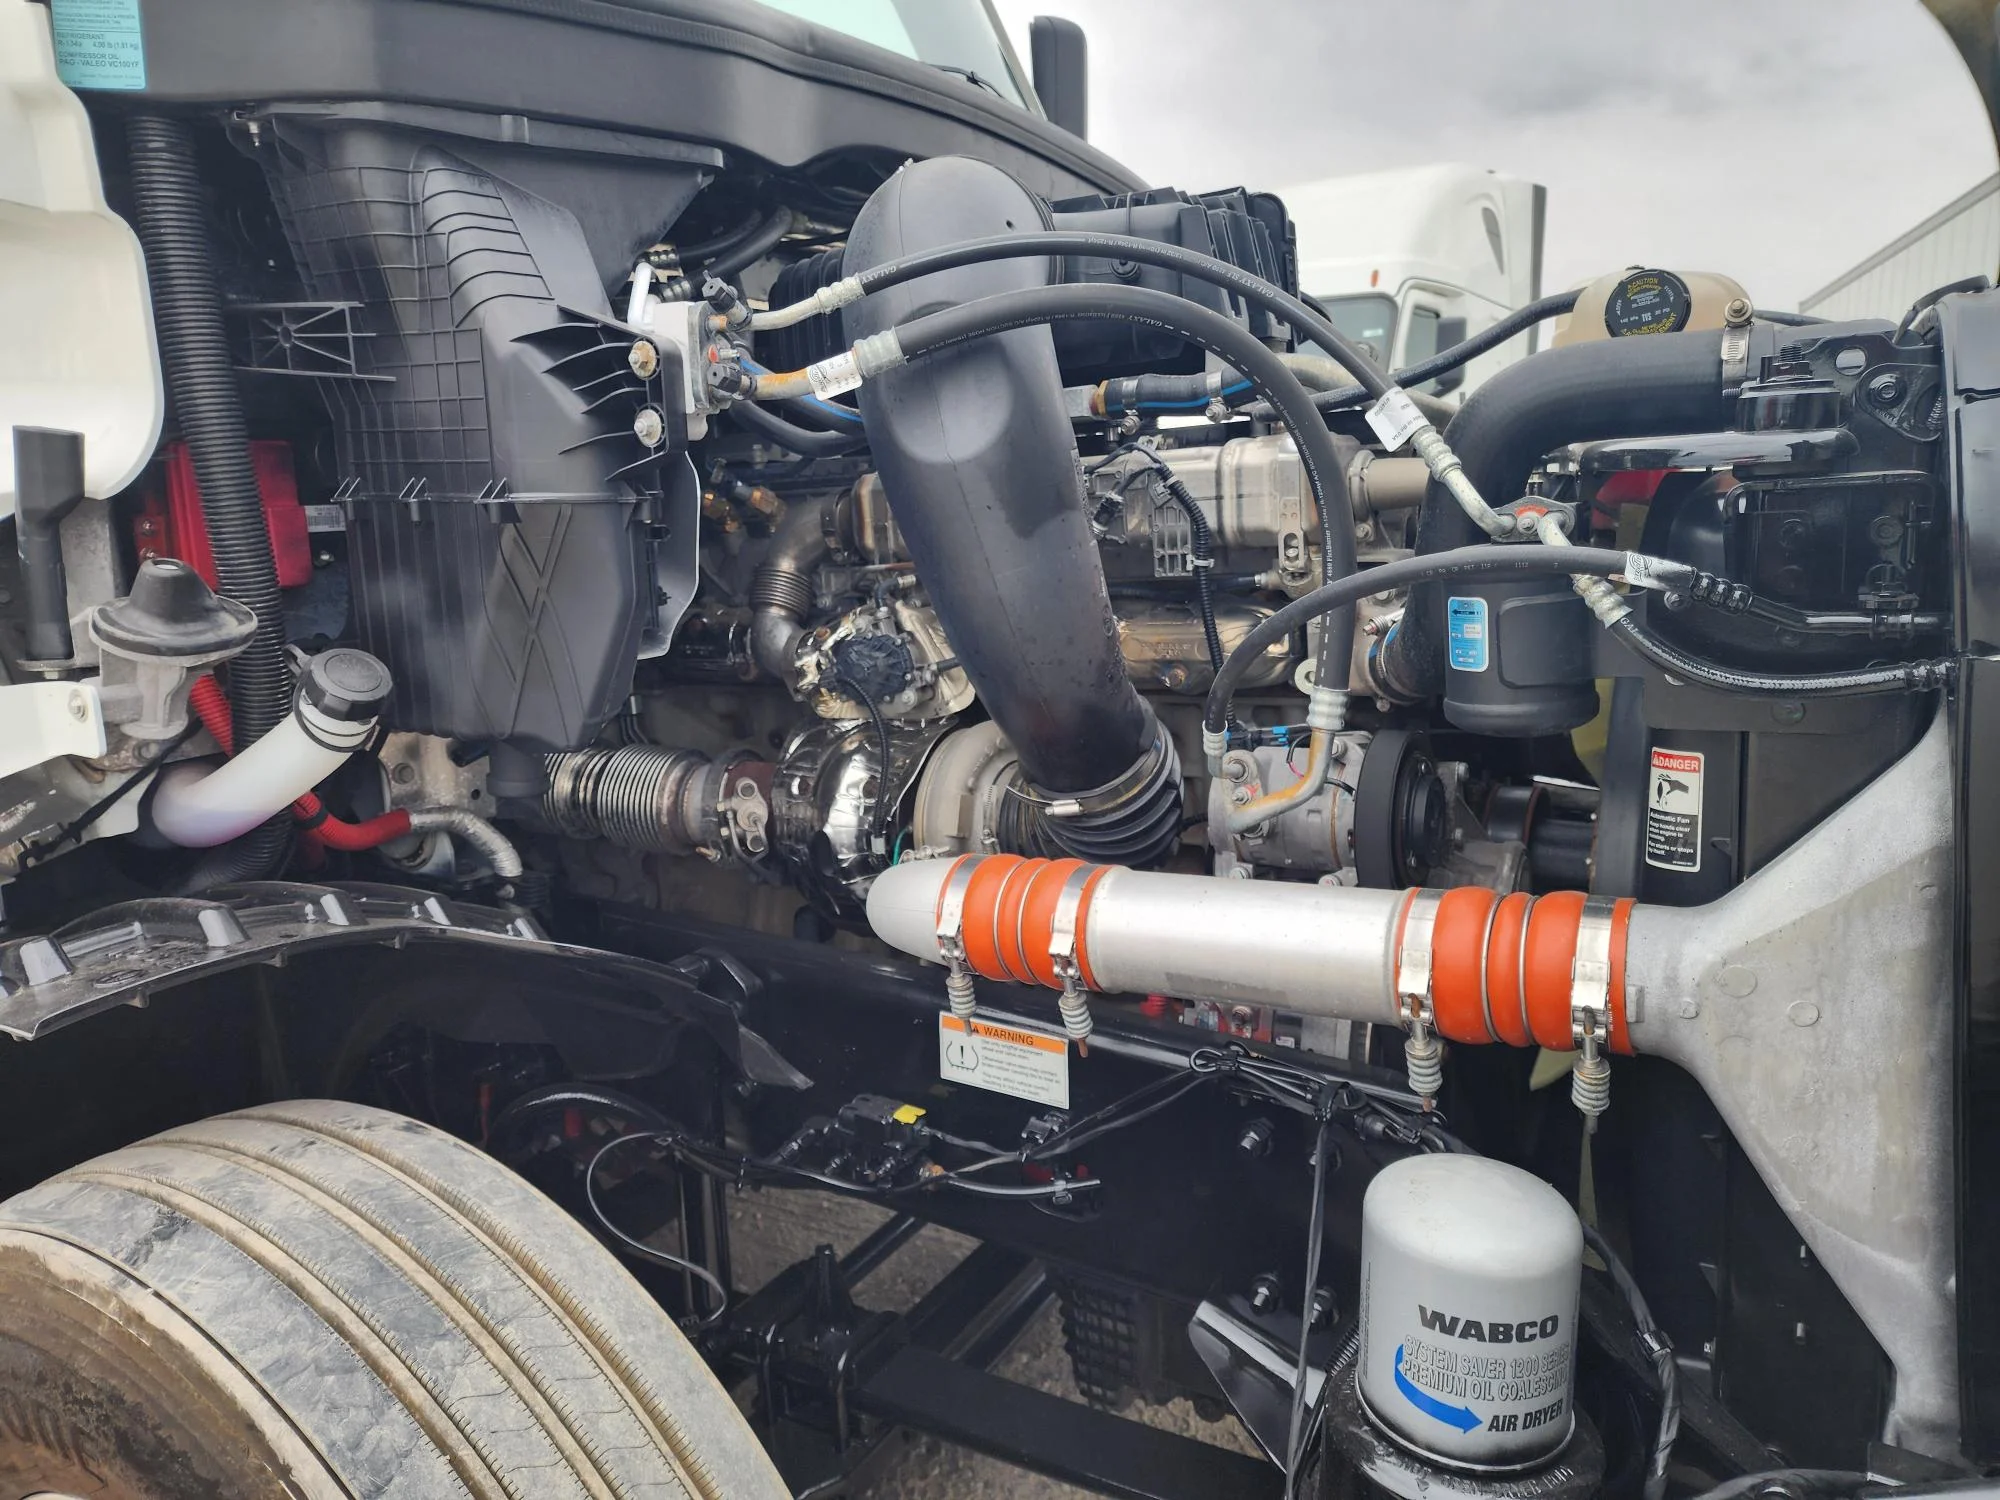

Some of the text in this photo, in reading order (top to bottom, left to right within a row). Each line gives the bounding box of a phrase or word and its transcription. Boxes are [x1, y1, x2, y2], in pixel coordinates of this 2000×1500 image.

[57, 32, 104, 40] REFRIGERANT
[862, 266, 896, 284] GALAXY
[1241, 279, 1275, 298] GALAXY
[1657, 757, 1699, 771] DANGER
[1650, 811, 1690, 824] Automatic Fan
[984, 1026, 1034, 1046] WARNING
[1418, 1304, 1559, 1344] WABCO
[1405, 1334, 1458, 1374] SYSTEM
[1461, 1354, 1506, 1379] SAVER
[1510, 1354, 1540, 1379] 1200
[1403, 1359, 1467, 1398] PREMIUM
[1470, 1379, 1495, 1401] OIL
[1488, 1399, 1564, 1432] AIR DRYER
